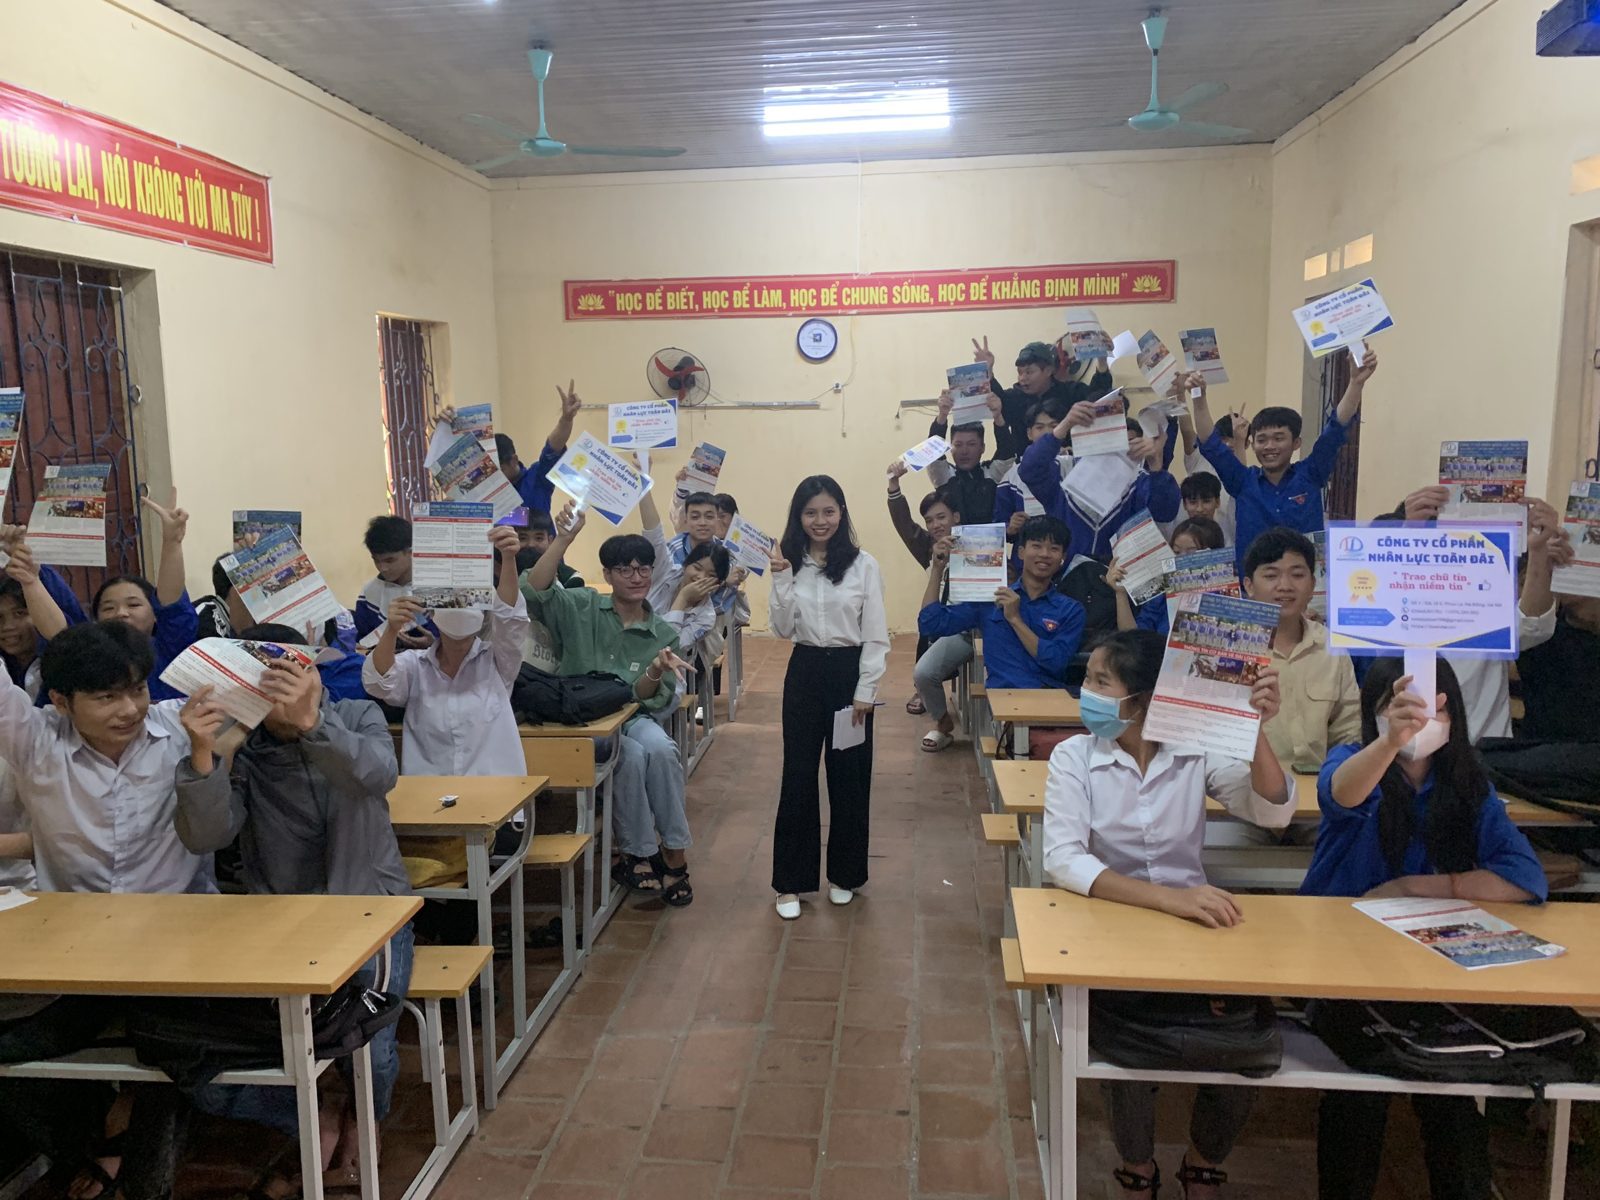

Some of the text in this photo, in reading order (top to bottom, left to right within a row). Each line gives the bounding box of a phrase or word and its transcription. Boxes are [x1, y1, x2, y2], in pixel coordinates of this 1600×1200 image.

[65, 138, 99, 209] LAI,
[101, 142, 131, 210] NÓI
[133, 155, 184, 223] KHÔNG
[185, 168, 208, 229] VỚI
[209, 183, 232, 235] MA
[231, 183, 252, 241] TÚY
[646, 285, 664, 311] ĐỂ
[666, 285, 699, 312] BIẾT,
[702, 290, 729, 313] HỌC
[733, 282, 750, 309] ĐỂ
[753, 285, 787, 310] LÀM,
[790, 288, 817, 311] HỌC
[821, 280, 840, 307] ĐỂ
[842, 286, 888, 306] CHUNG
[892, 279, 934, 305] SỐNG,
[938, 282, 966, 306] HỌC
[969, 274, 989, 301] ĐỂ
[991, 272, 1040, 300] KHẲNG
[1045, 277, 1079, 301] ĐỊNH
[1377, 535, 1410, 547] CÔNG
[1413, 538, 1429, 548] TY
[1432, 533, 1448, 548] CỔ
[1450, 534, 1485, 549] PHẦN
[1368, 551, 1403, 562] NHÂN
[1406, 553, 1430, 566] LỰC
[1401, 572, 1426, 581] Trao
